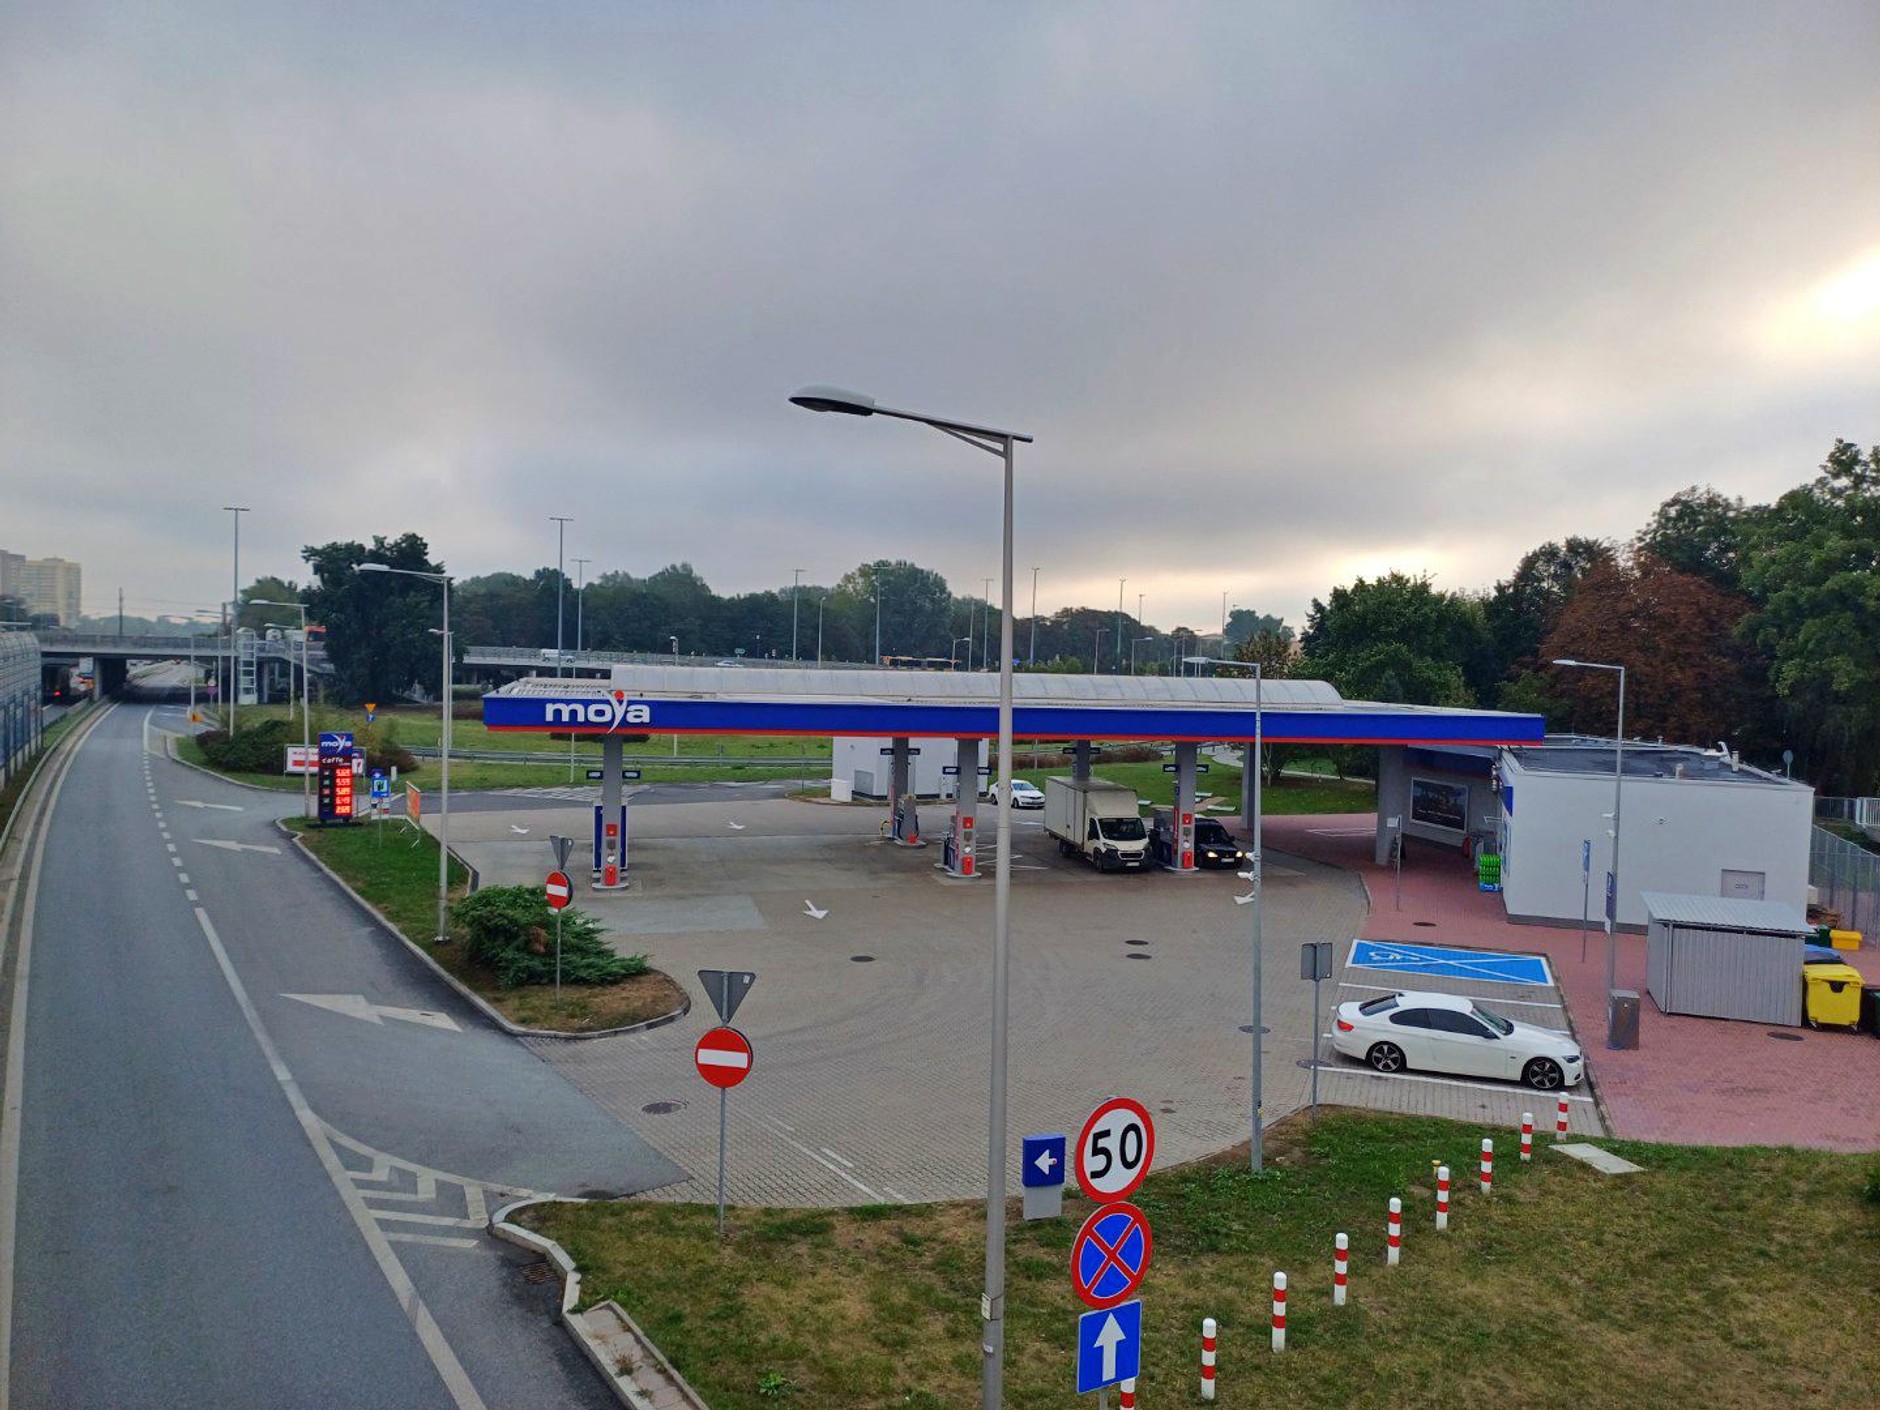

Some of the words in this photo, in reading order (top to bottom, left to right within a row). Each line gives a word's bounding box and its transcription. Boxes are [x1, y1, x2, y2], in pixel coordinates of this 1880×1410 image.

[545, 691, 651, 734] moya
[321, 734, 352, 754] moya
[1090, 1123, 1143, 1179] 50
